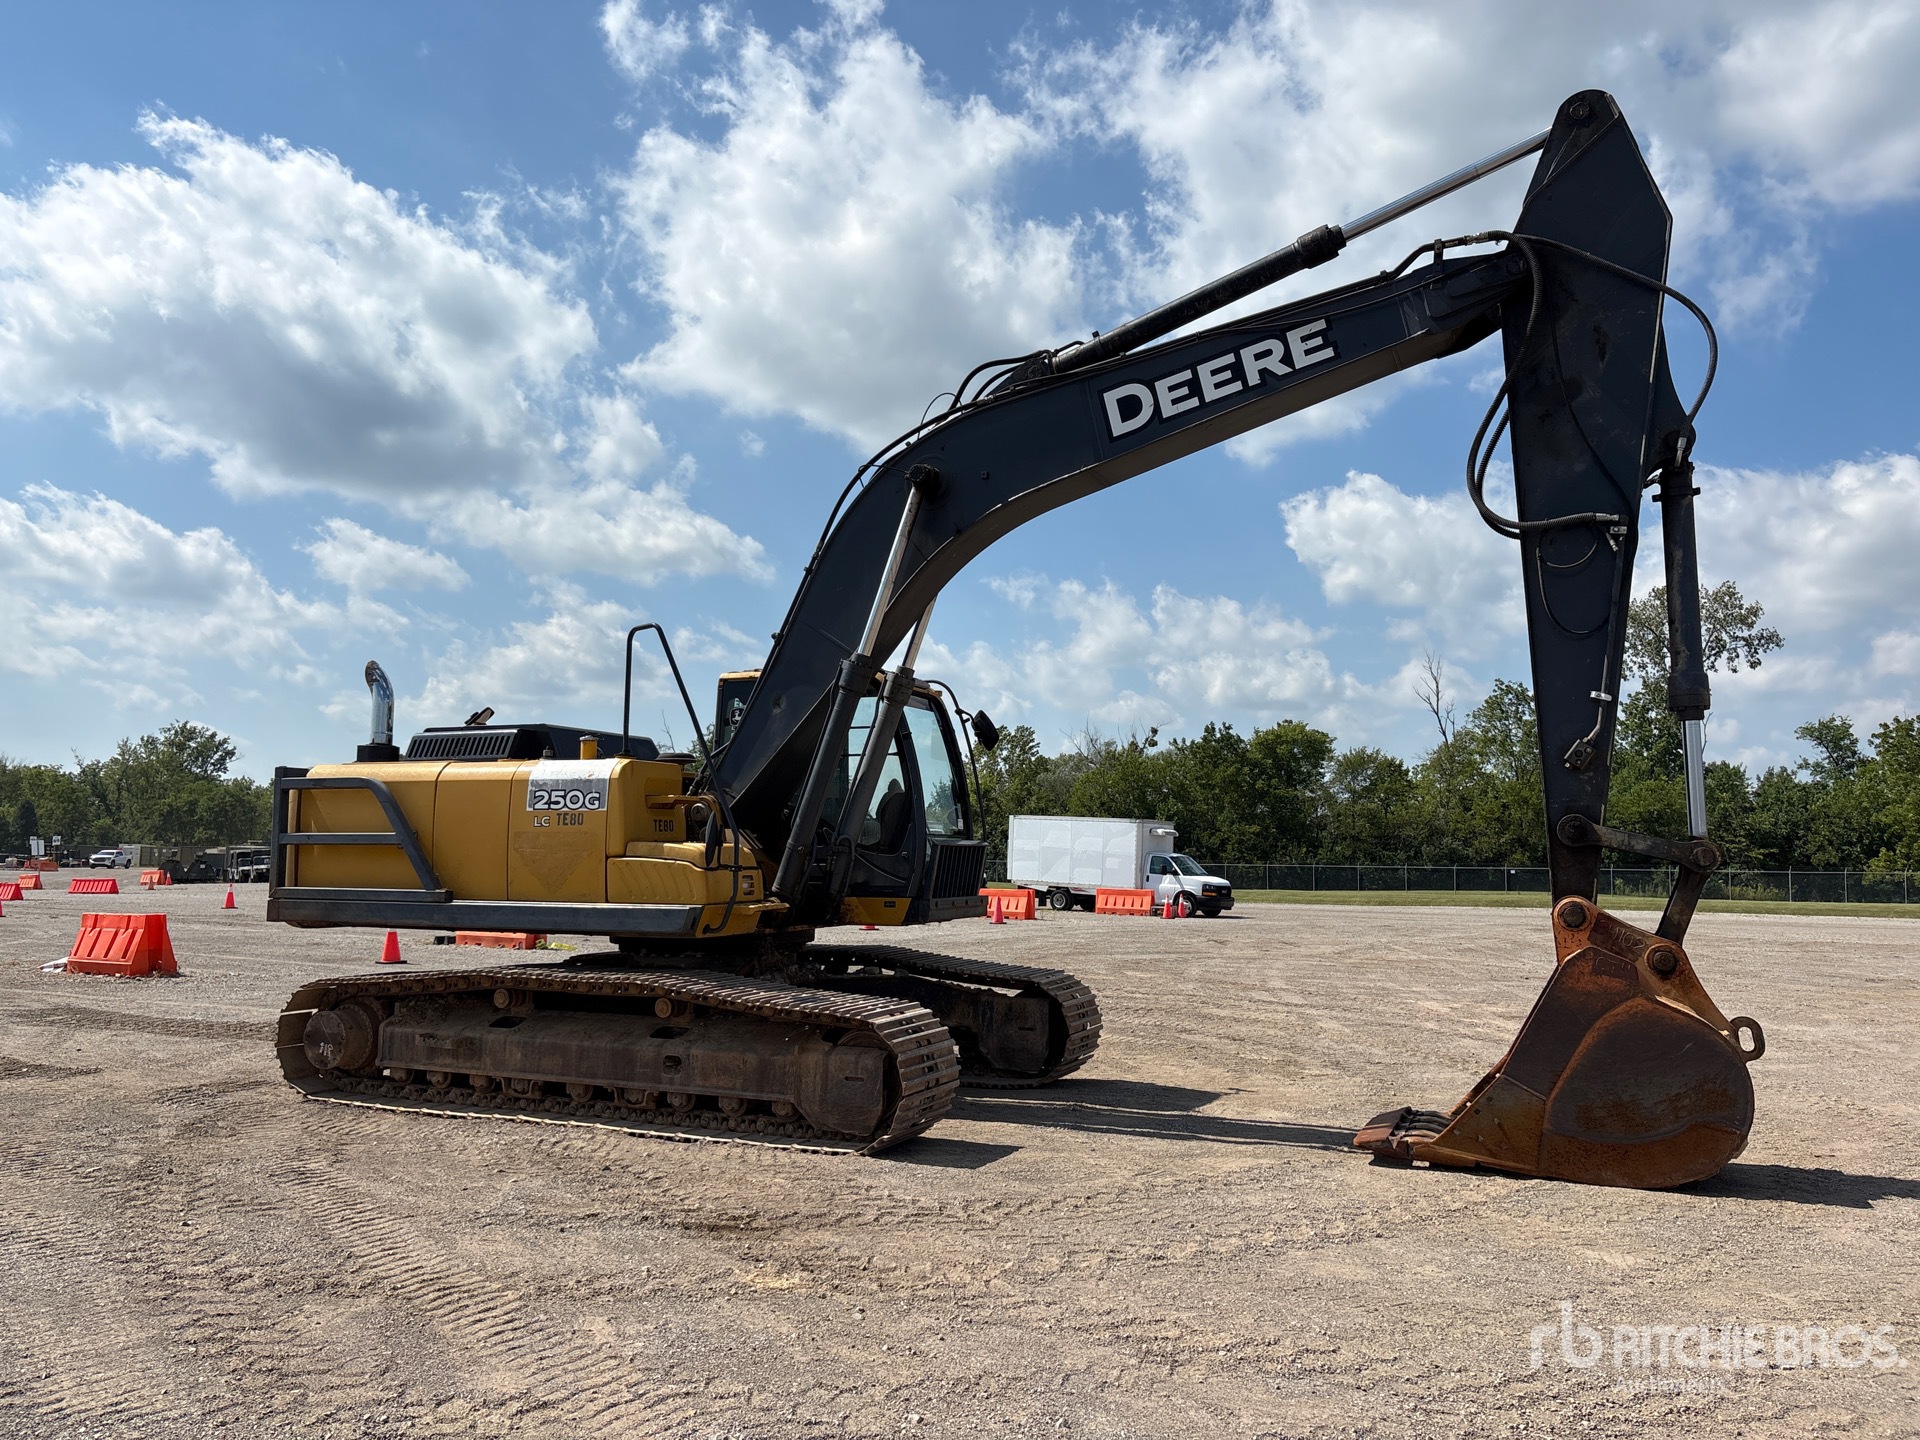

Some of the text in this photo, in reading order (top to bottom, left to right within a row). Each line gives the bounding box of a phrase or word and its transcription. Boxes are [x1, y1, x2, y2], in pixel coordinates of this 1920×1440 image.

[1103, 318, 1335, 438] DEERE
[533, 789, 601, 811] 250G
[533, 812, 584, 827] LC TE80
[653, 819, 675, 833] TE80
